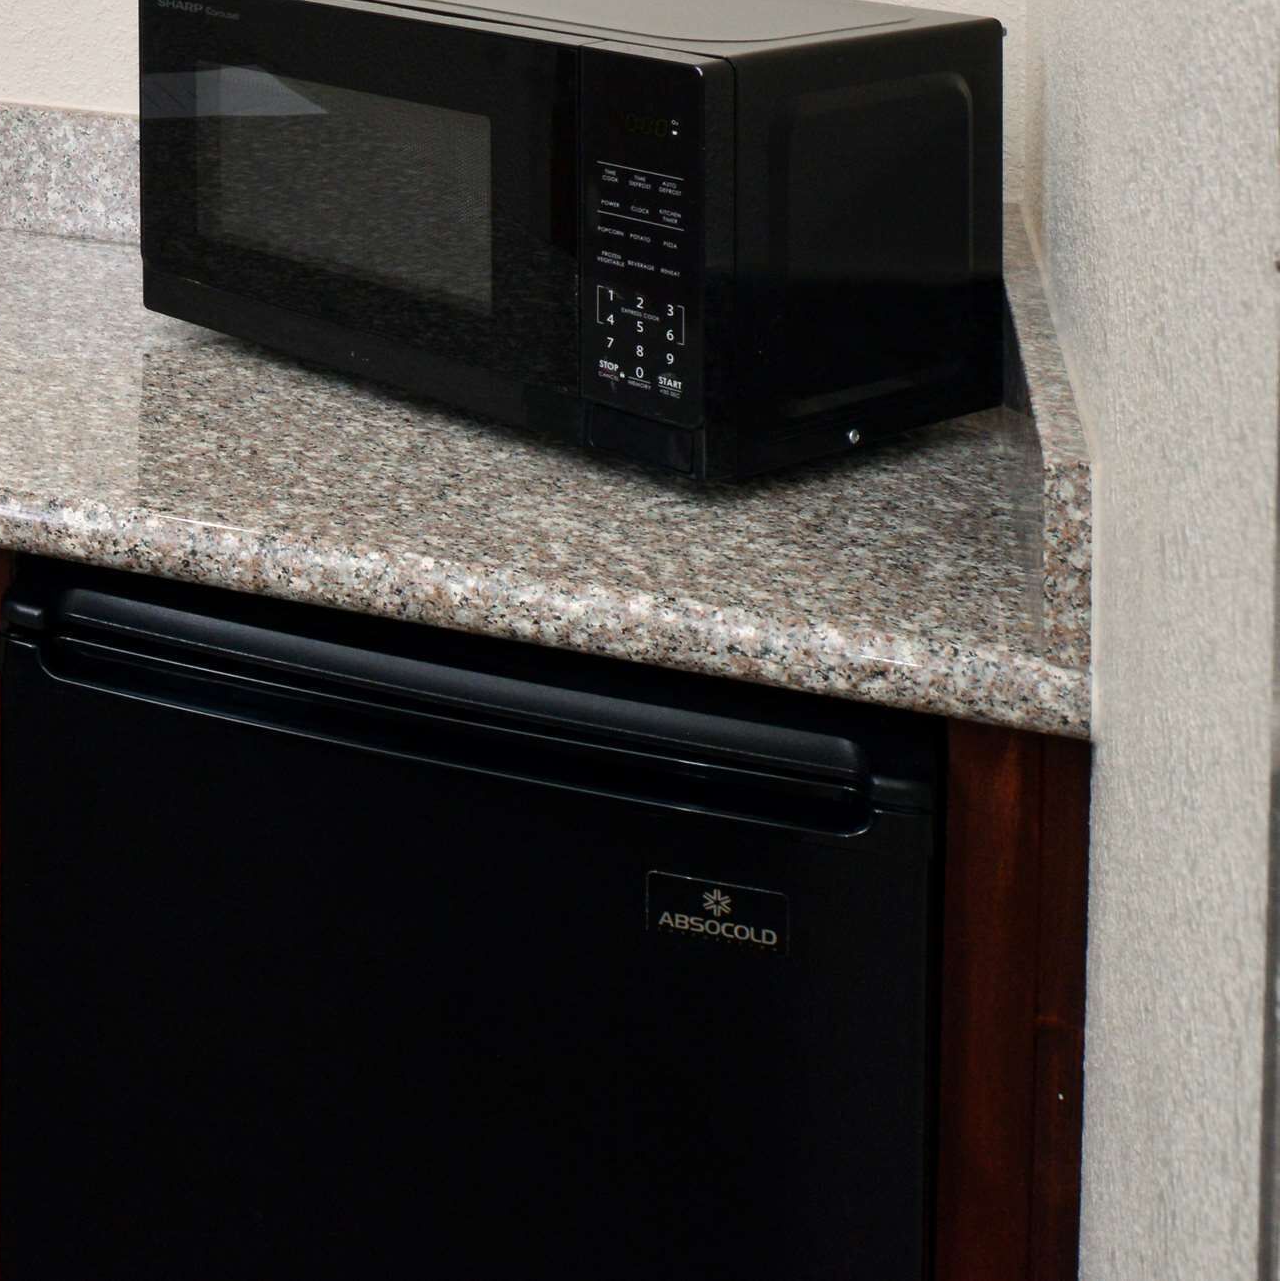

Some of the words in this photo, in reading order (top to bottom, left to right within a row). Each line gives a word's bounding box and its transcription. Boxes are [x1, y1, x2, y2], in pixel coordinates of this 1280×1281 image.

[662, 180, 678, 189] AUTO
[600, 199, 620, 208] POWER
[630, 205, 650, 215] CLOCK
[659, 208, 682, 219] KITCHEN
[597, 225, 624, 237] POPCORN
[629, 233, 652, 244] POTATO
[663, 240, 678, 249] PIZZA
[601, 250, 622, 260] FROZEN
[596, 256, 625, 268] VEGETABLE
[627, 260, 655, 272] BEVERAGE
[608, 290, 614, 301] 1
[636, 297, 644, 309] 2
[667, 305, 674, 317] 3
[606, 314, 615, 326] 4
[636, 321, 644, 333] 5
[667, 329, 674, 341] 6
[606, 337, 614, 348] 7
[636, 345, 644, 357] 8
[599, 359, 619, 371] STOP
[666, 353, 674, 365] 9
[635, 366, 644, 379] 0
[658, 375, 682, 390] START
[658, 911, 778, 946] ABSOCOLD
